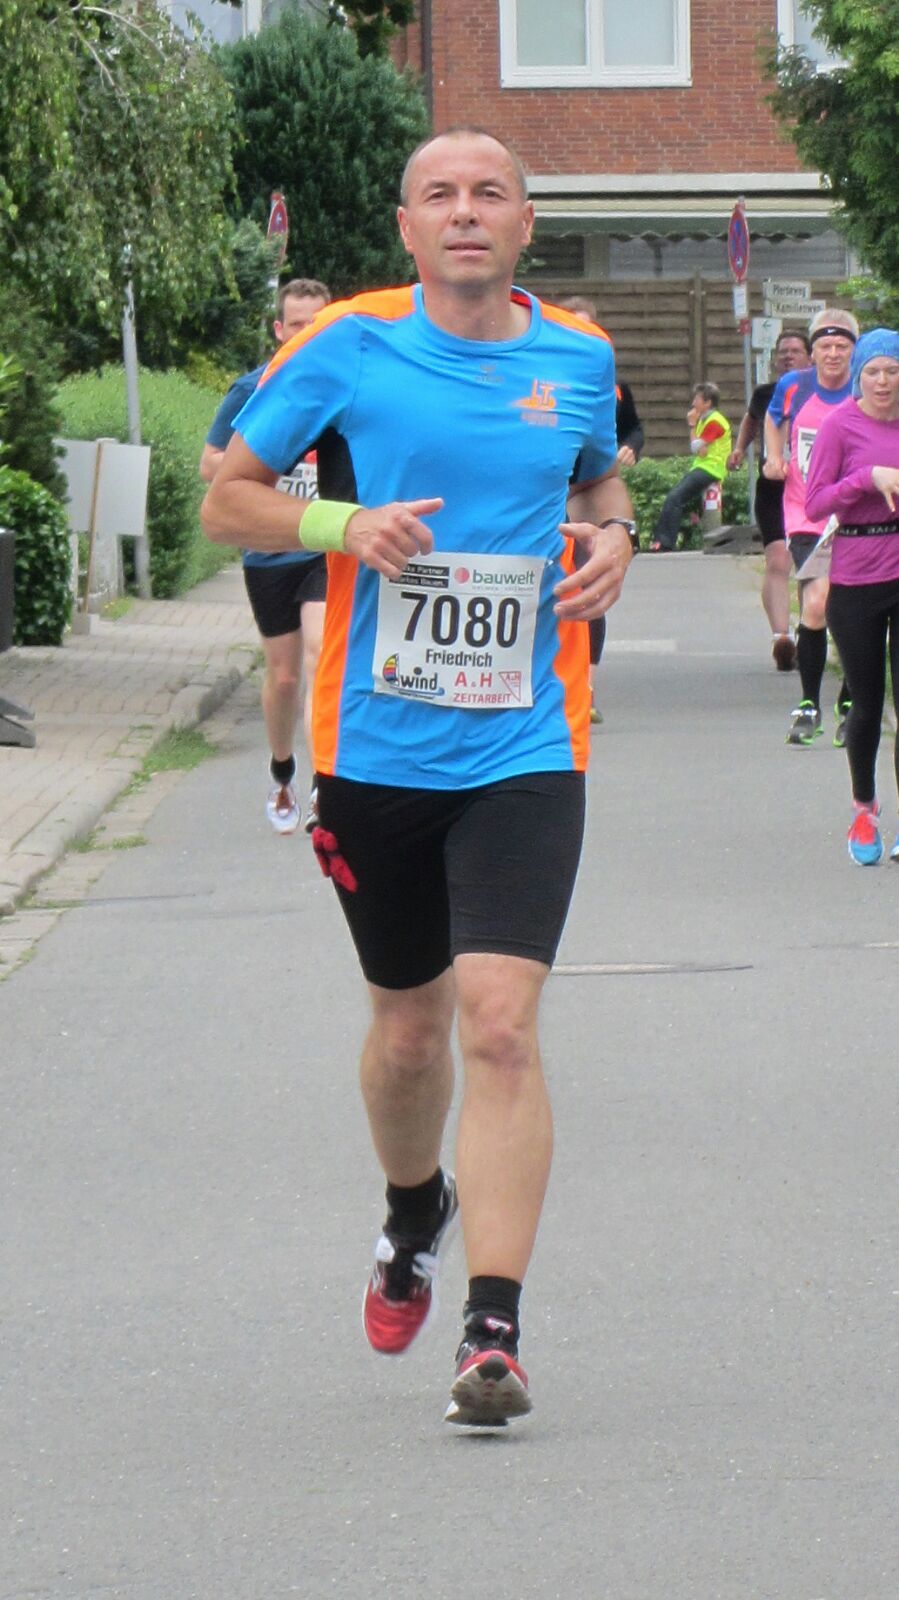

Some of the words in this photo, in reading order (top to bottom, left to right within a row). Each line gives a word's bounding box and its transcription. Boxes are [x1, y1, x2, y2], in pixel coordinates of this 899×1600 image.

[473, 569, 535, 585] bauwelt
[401, 591, 521, 649] 7080
[425, 648, 493, 668] Friedrich
[400, 667, 438, 690] wind
[453, 692, 512, 704] ZEITARBEIT
